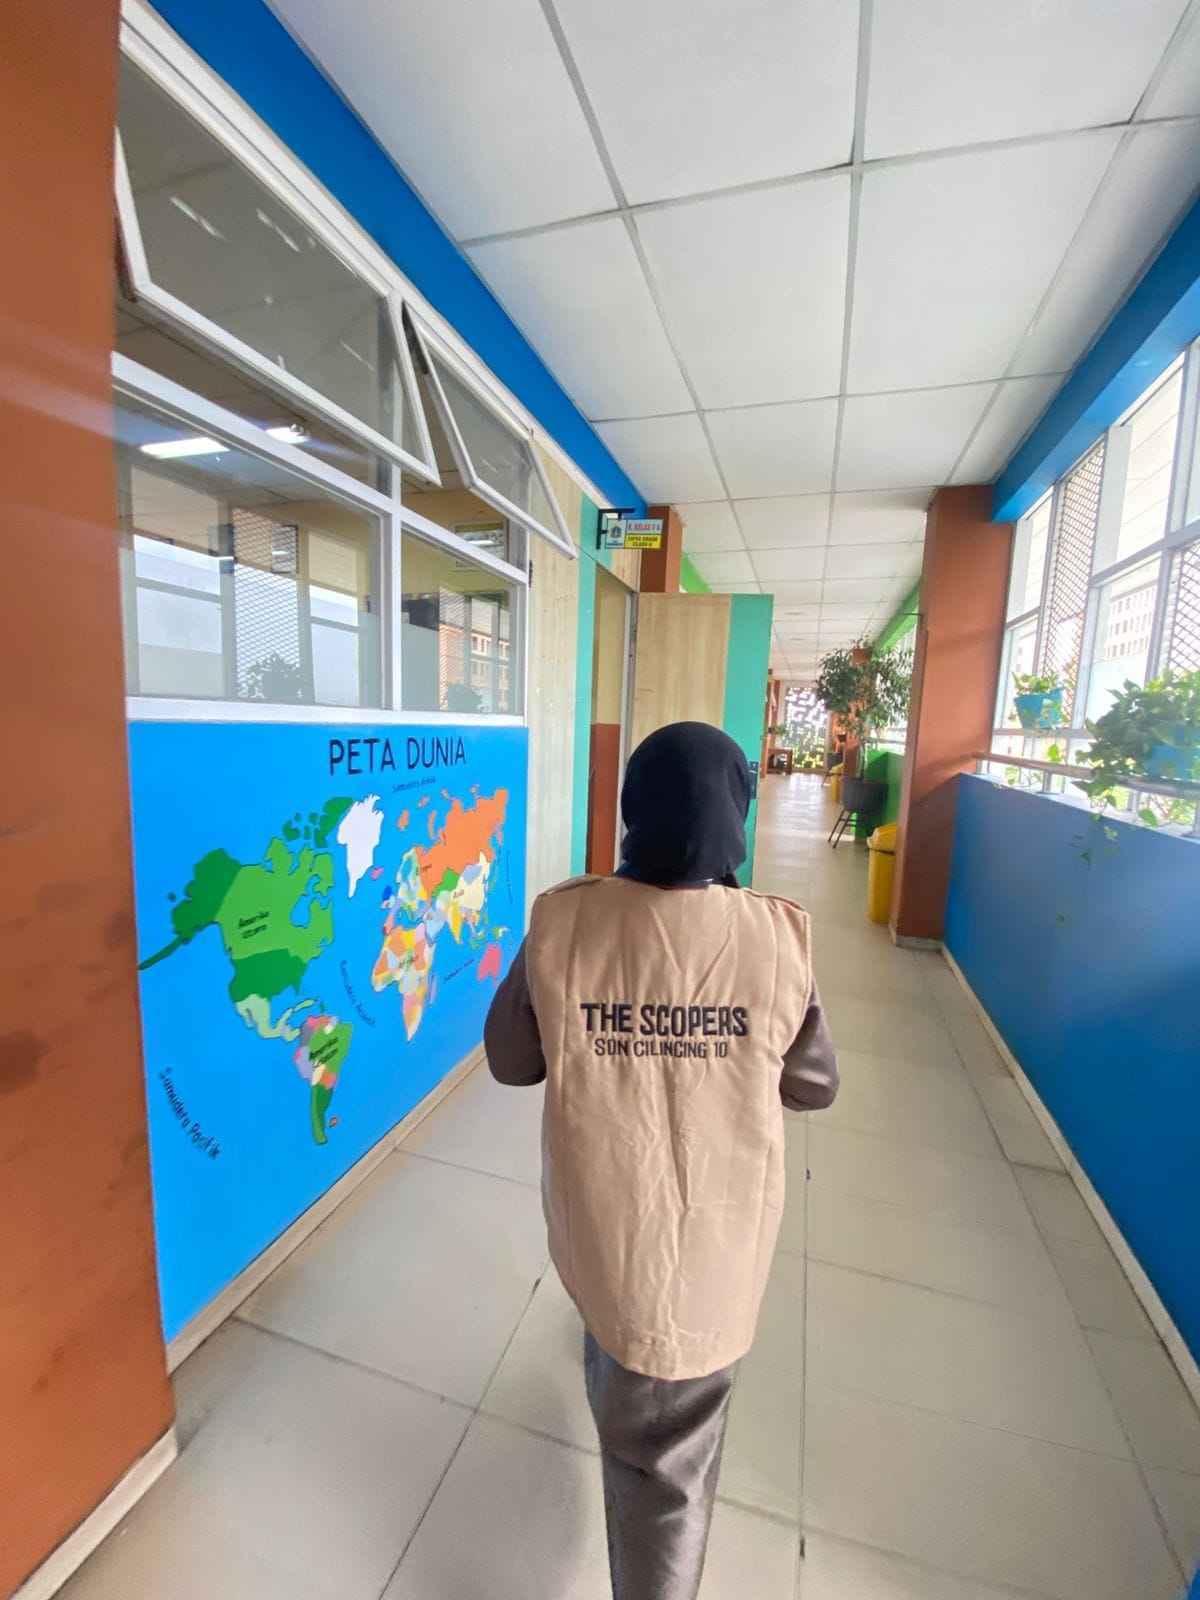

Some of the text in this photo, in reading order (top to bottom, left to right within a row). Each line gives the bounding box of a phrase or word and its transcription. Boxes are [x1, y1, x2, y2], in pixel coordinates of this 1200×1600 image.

[328, 736, 467, 776] PETA DUNIA
[580, 1003, 749, 1037] THE SCOPERS
[594, 1038, 728, 1059] SDN CILINCING 10
